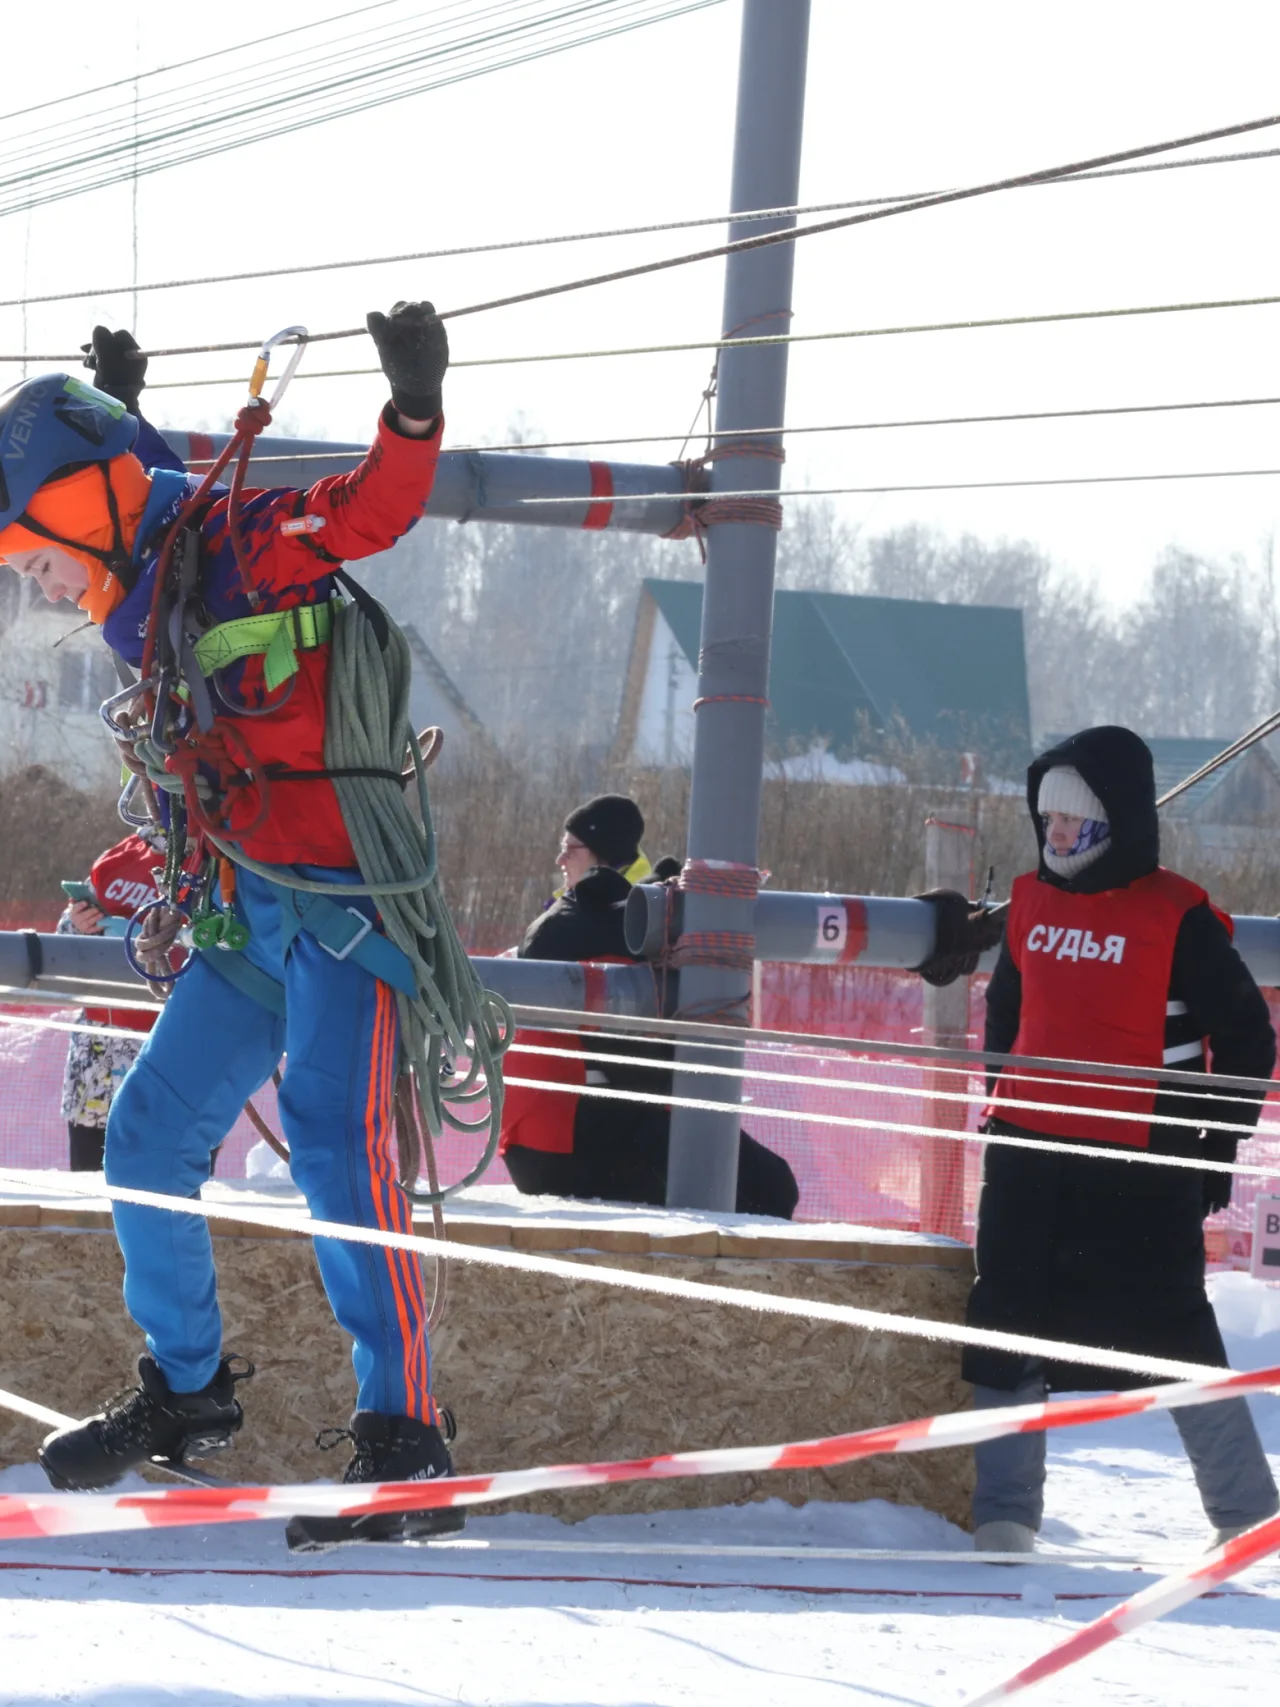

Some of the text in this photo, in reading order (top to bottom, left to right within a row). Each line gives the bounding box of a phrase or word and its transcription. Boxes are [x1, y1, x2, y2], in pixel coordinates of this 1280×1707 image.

[3, 382, 47, 459] VENTO
[823, 915, 840, 941] 6
[1027, 924, 1126, 964] СУДЬЯ
